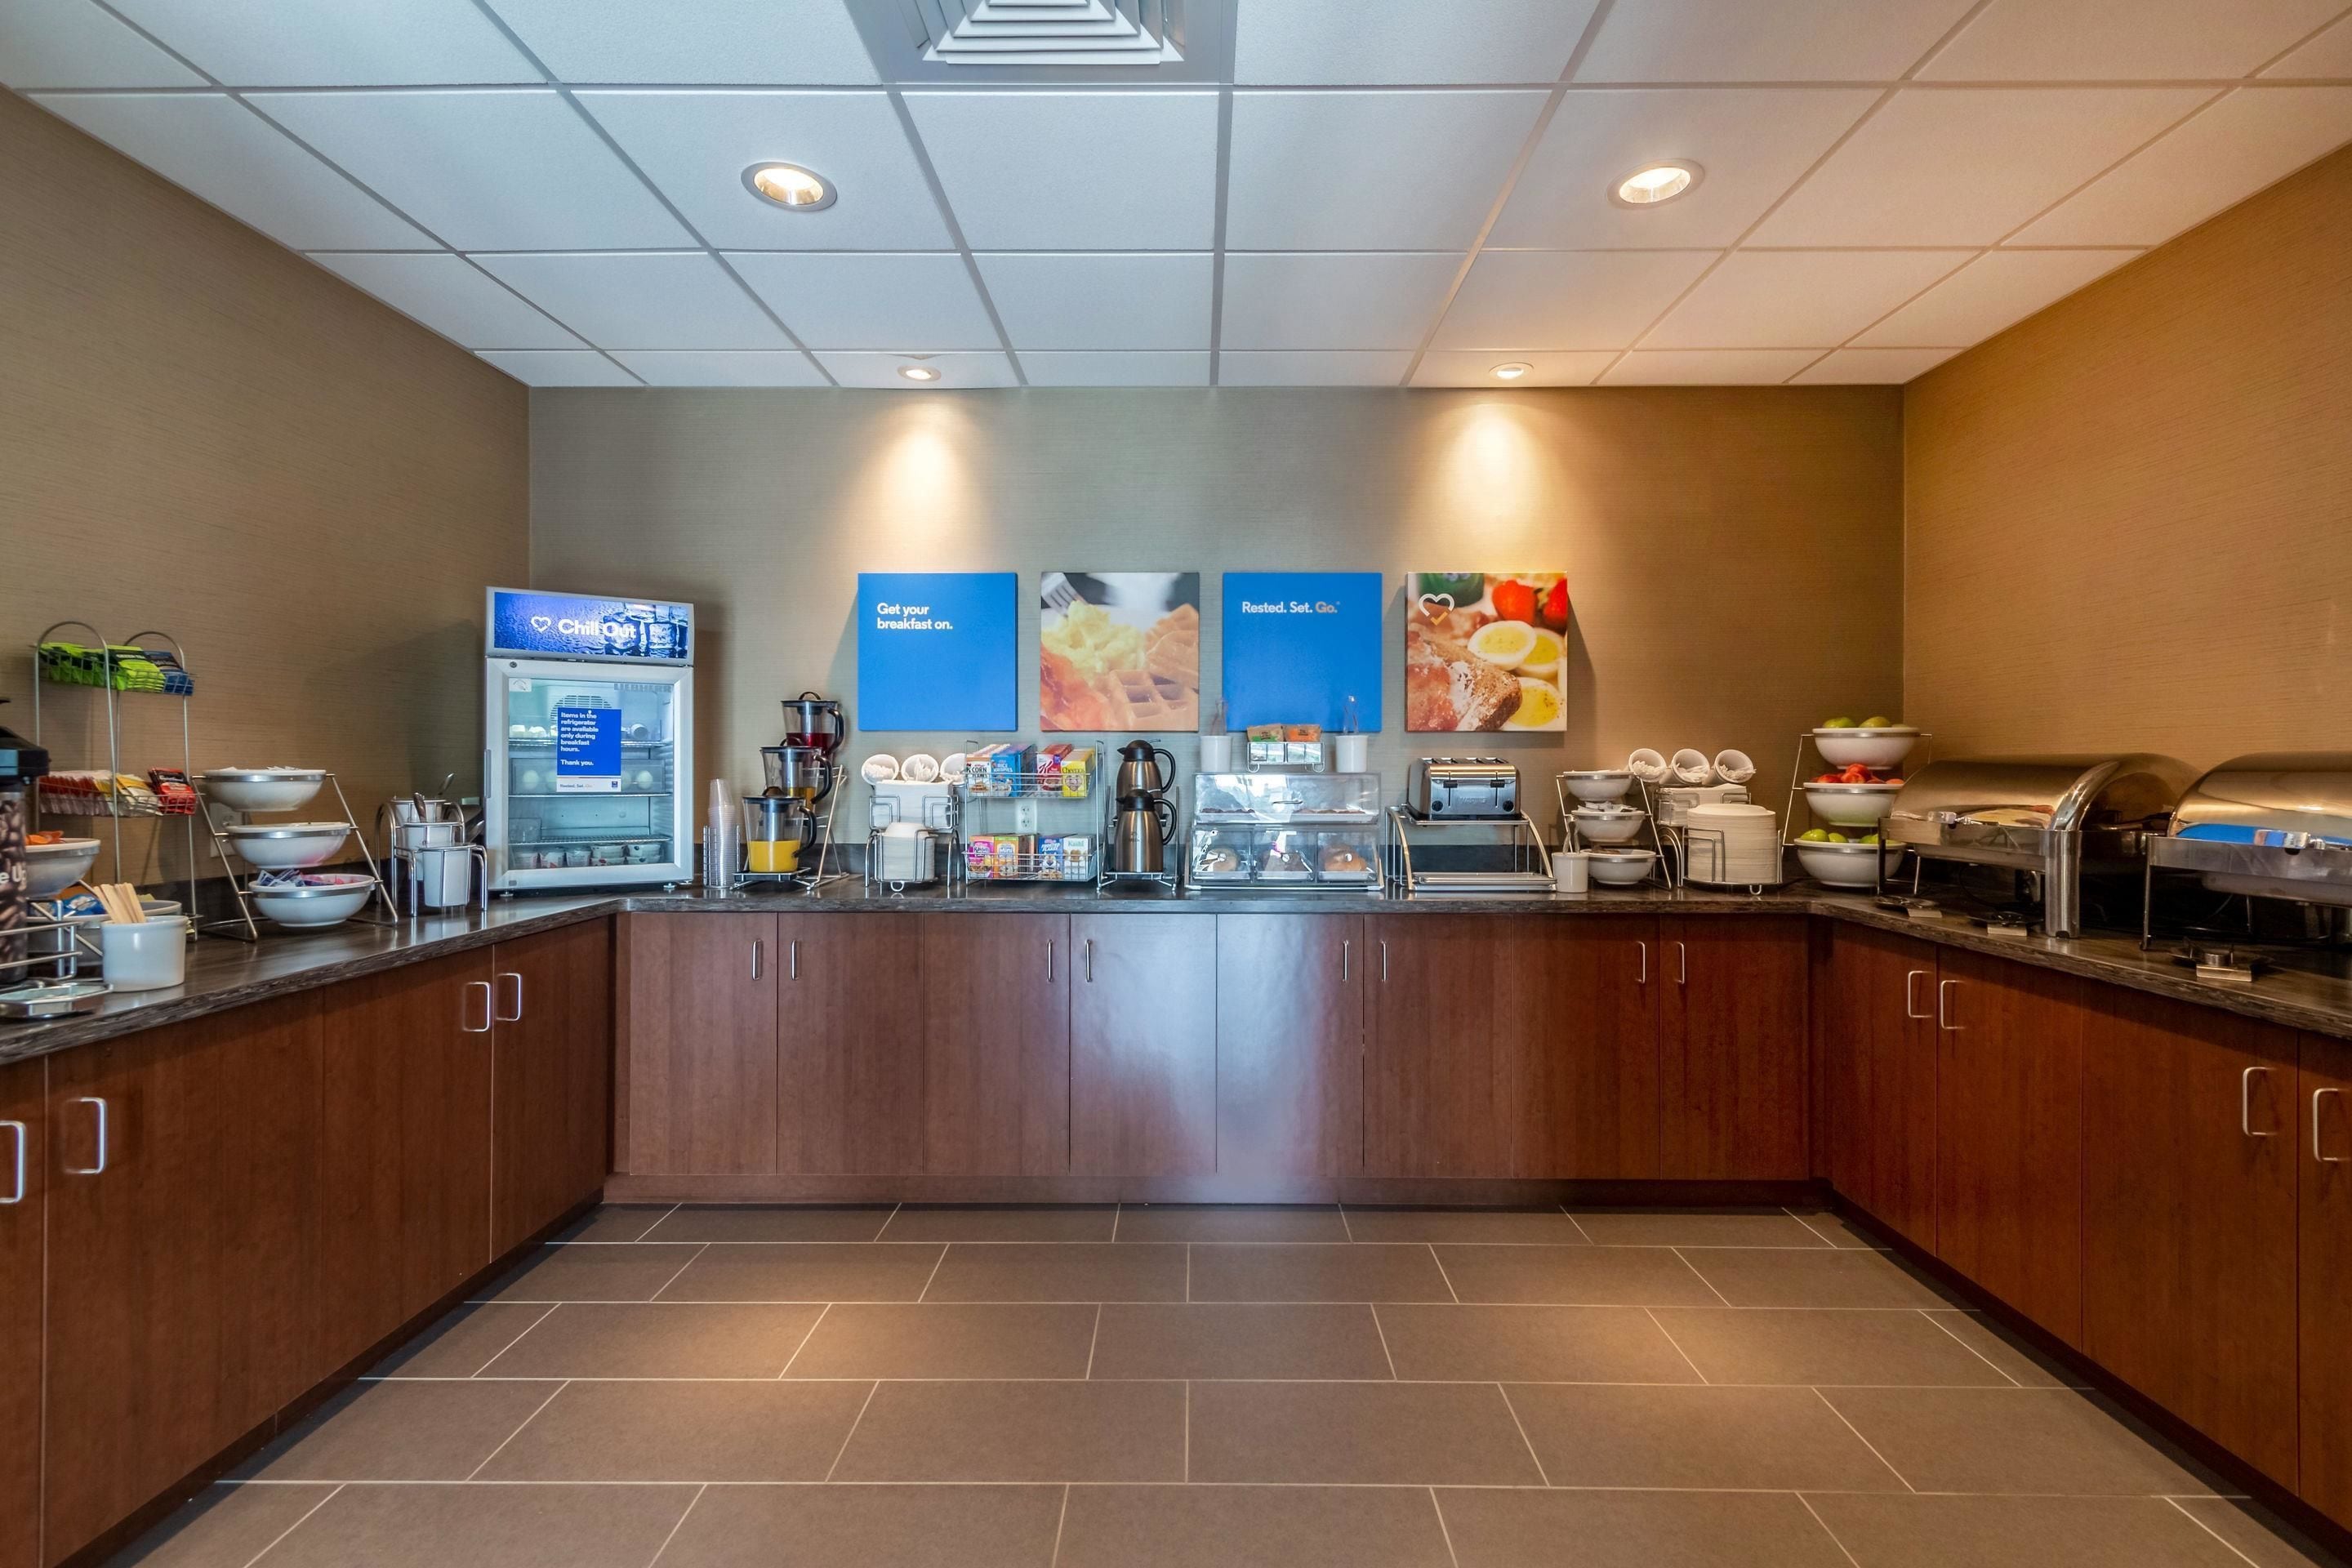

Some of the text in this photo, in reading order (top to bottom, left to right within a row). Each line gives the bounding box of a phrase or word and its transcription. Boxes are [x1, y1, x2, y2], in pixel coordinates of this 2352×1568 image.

[877, 603, 929, 617] Get your
[1242, 601, 1338, 613] Rested. Set. Go.
[558, 618, 636, 638] Chill Out
[877, 617, 953, 630] breakfast on.
